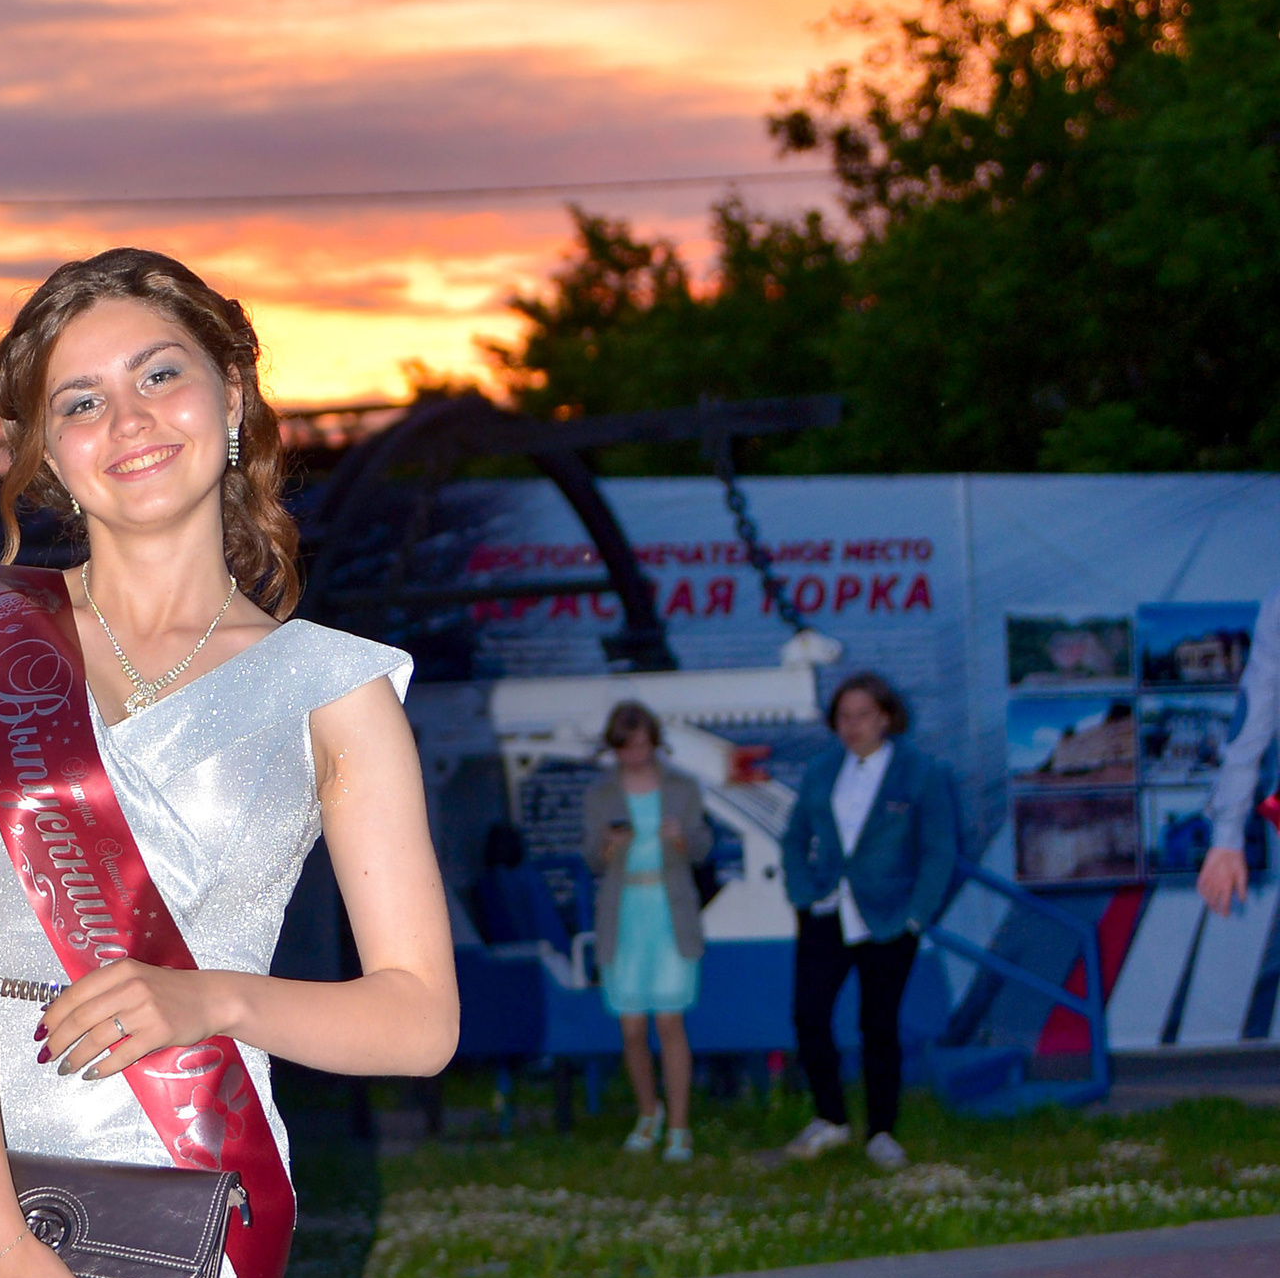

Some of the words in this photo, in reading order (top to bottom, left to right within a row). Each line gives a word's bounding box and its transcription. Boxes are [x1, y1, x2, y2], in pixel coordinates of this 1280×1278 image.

[842, 537, 933, 563] МЕСТО
[472, 576, 735, 620] КРАСАЯ
[762, 573, 933, 615] ГОРКА
[60, 756, 97, 827] Виктория
